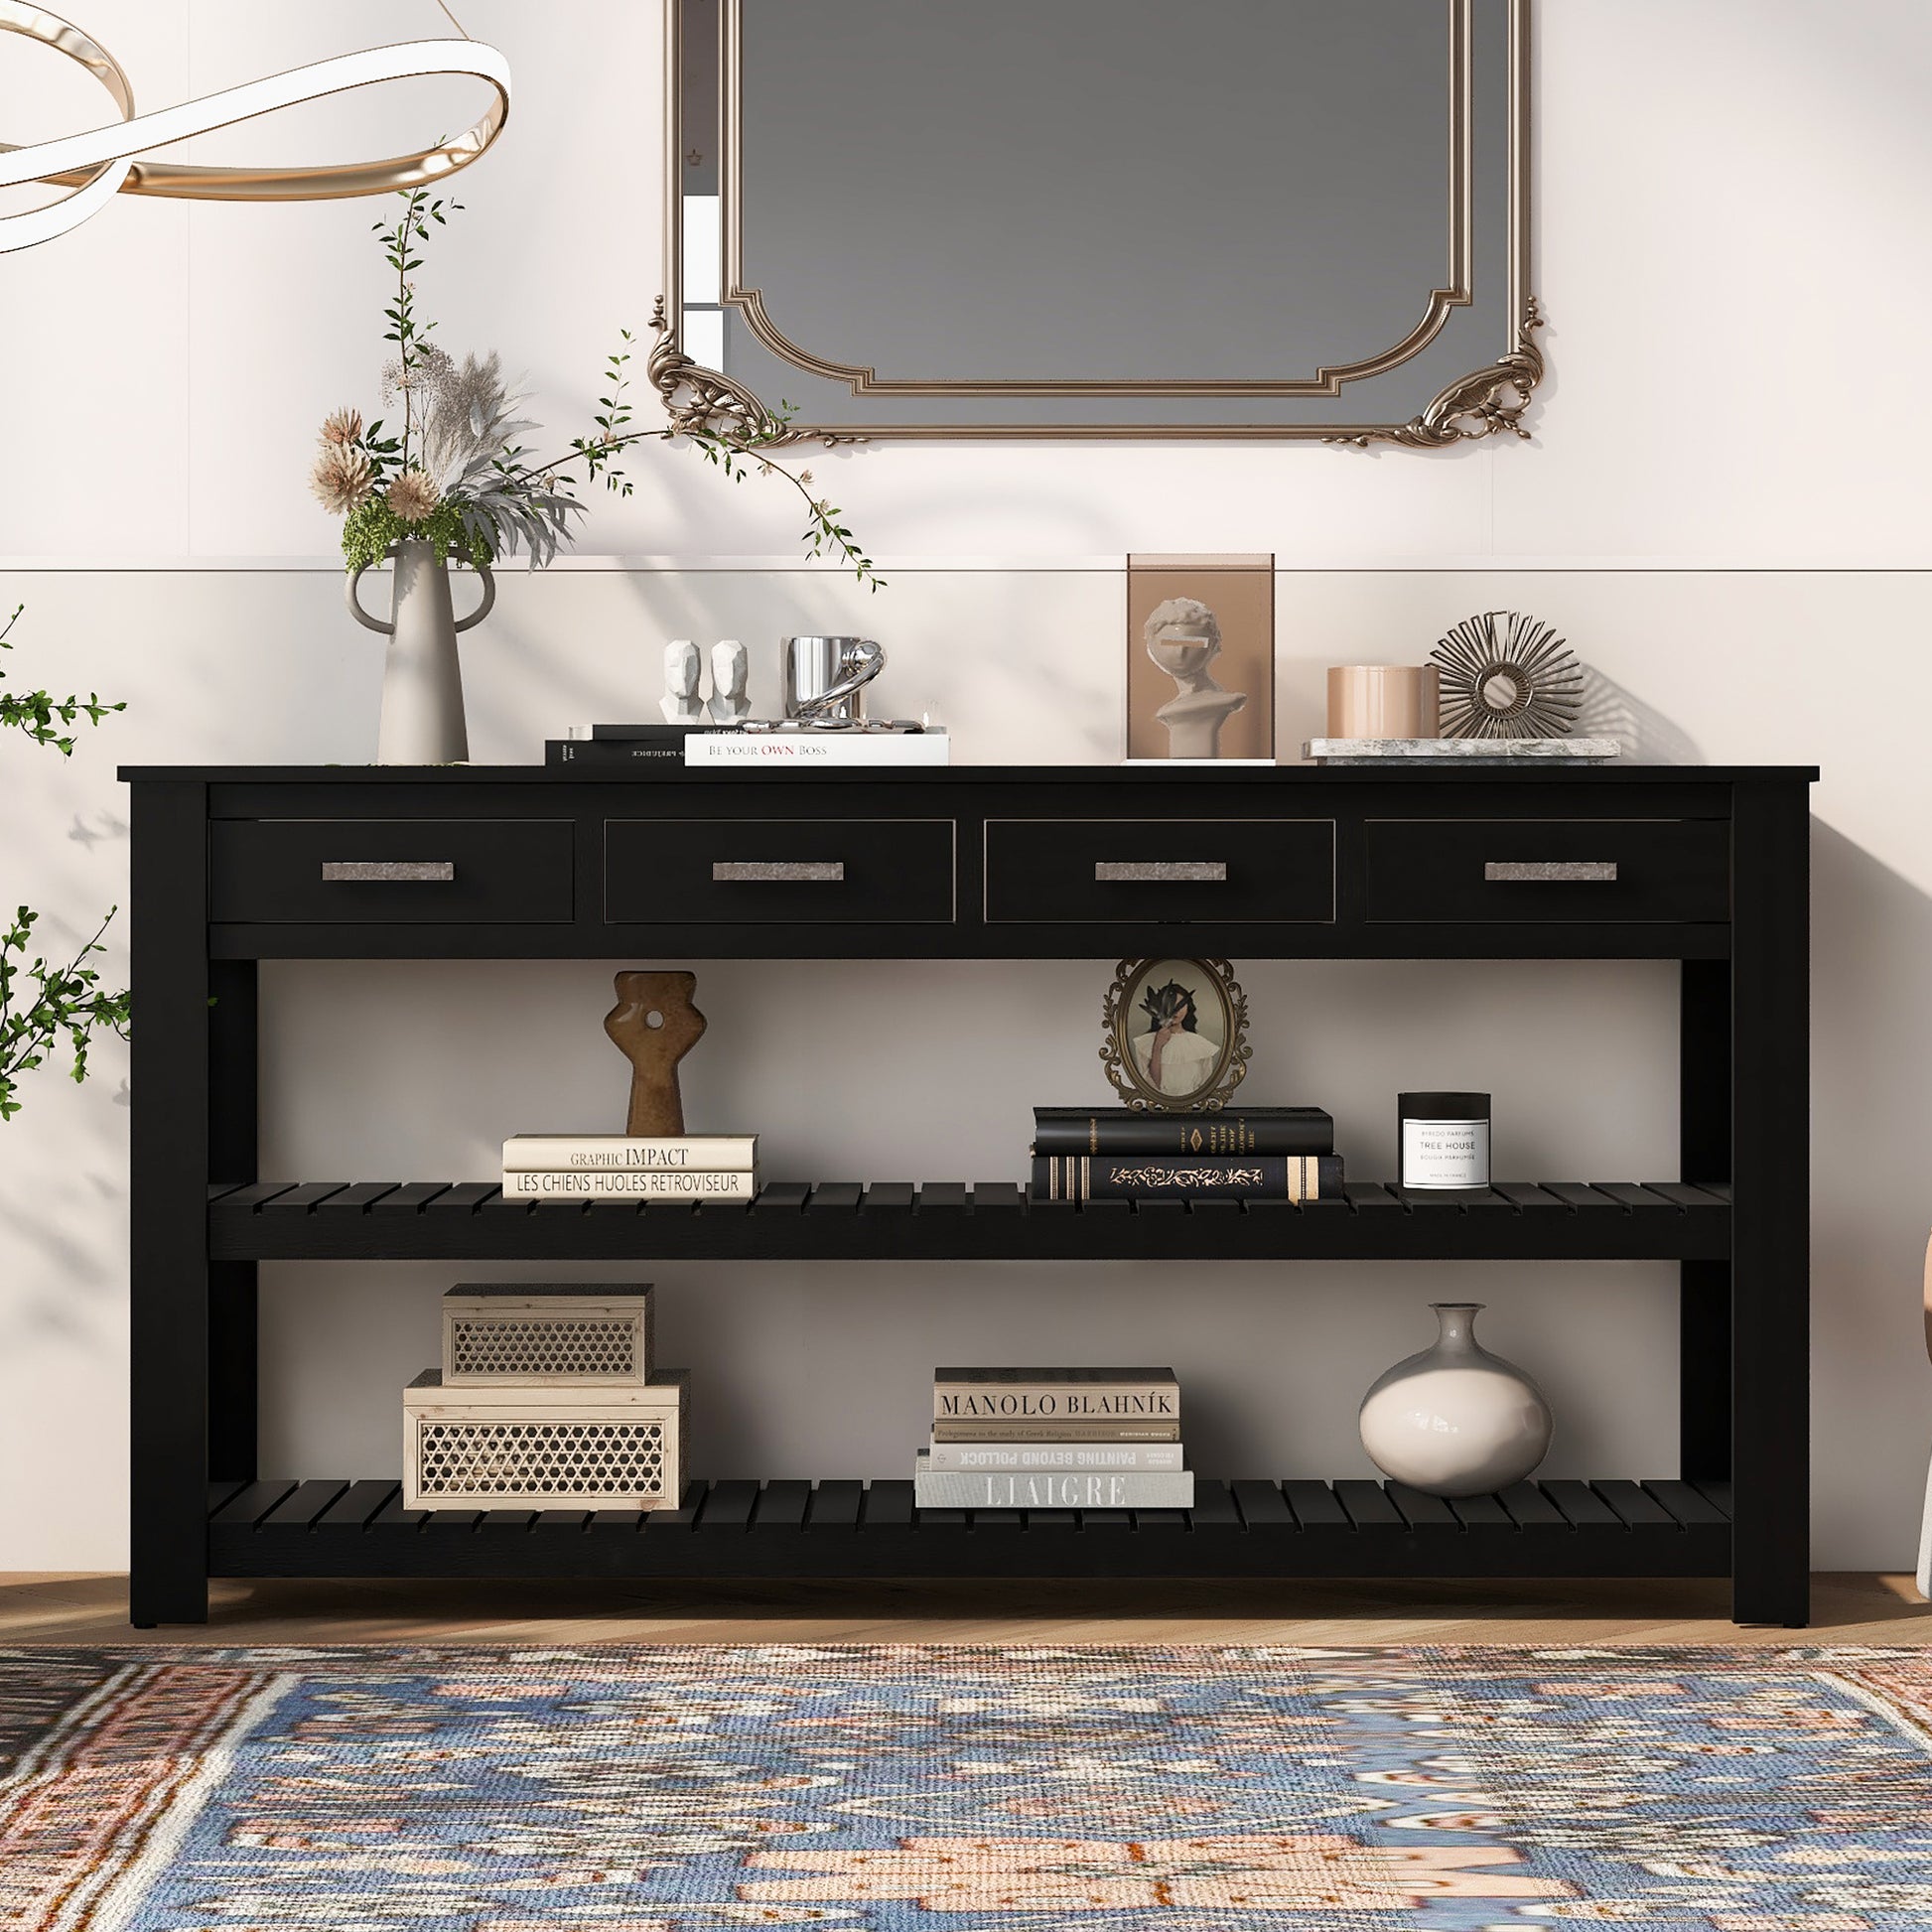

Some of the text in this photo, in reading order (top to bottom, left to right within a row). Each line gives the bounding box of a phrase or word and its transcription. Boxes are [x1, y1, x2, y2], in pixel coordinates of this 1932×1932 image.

[709, 745, 723, 756] BE
[726, 745, 759, 756] YOUR
[760, 745, 794, 756] OWN
[1420, 1141, 1476, 1150] TREE HOUSE
[570, 1148, 689, 1167] GRAPHIC IMPACT
[516, 1174, 739, 1192] LES CHIENS HUOLES RETROVISEUR
[940, 1391, 1173, 1416] MANOLO BLAHNÍK
[960, 1451, 1018, 1465] POLLOCK
[1022, 1451, 1073, 1465] BEYOND
[1077, 1451, 1137, 1465] PAINTING
[986, 1475, 1126, 1506] LIAIGRE
